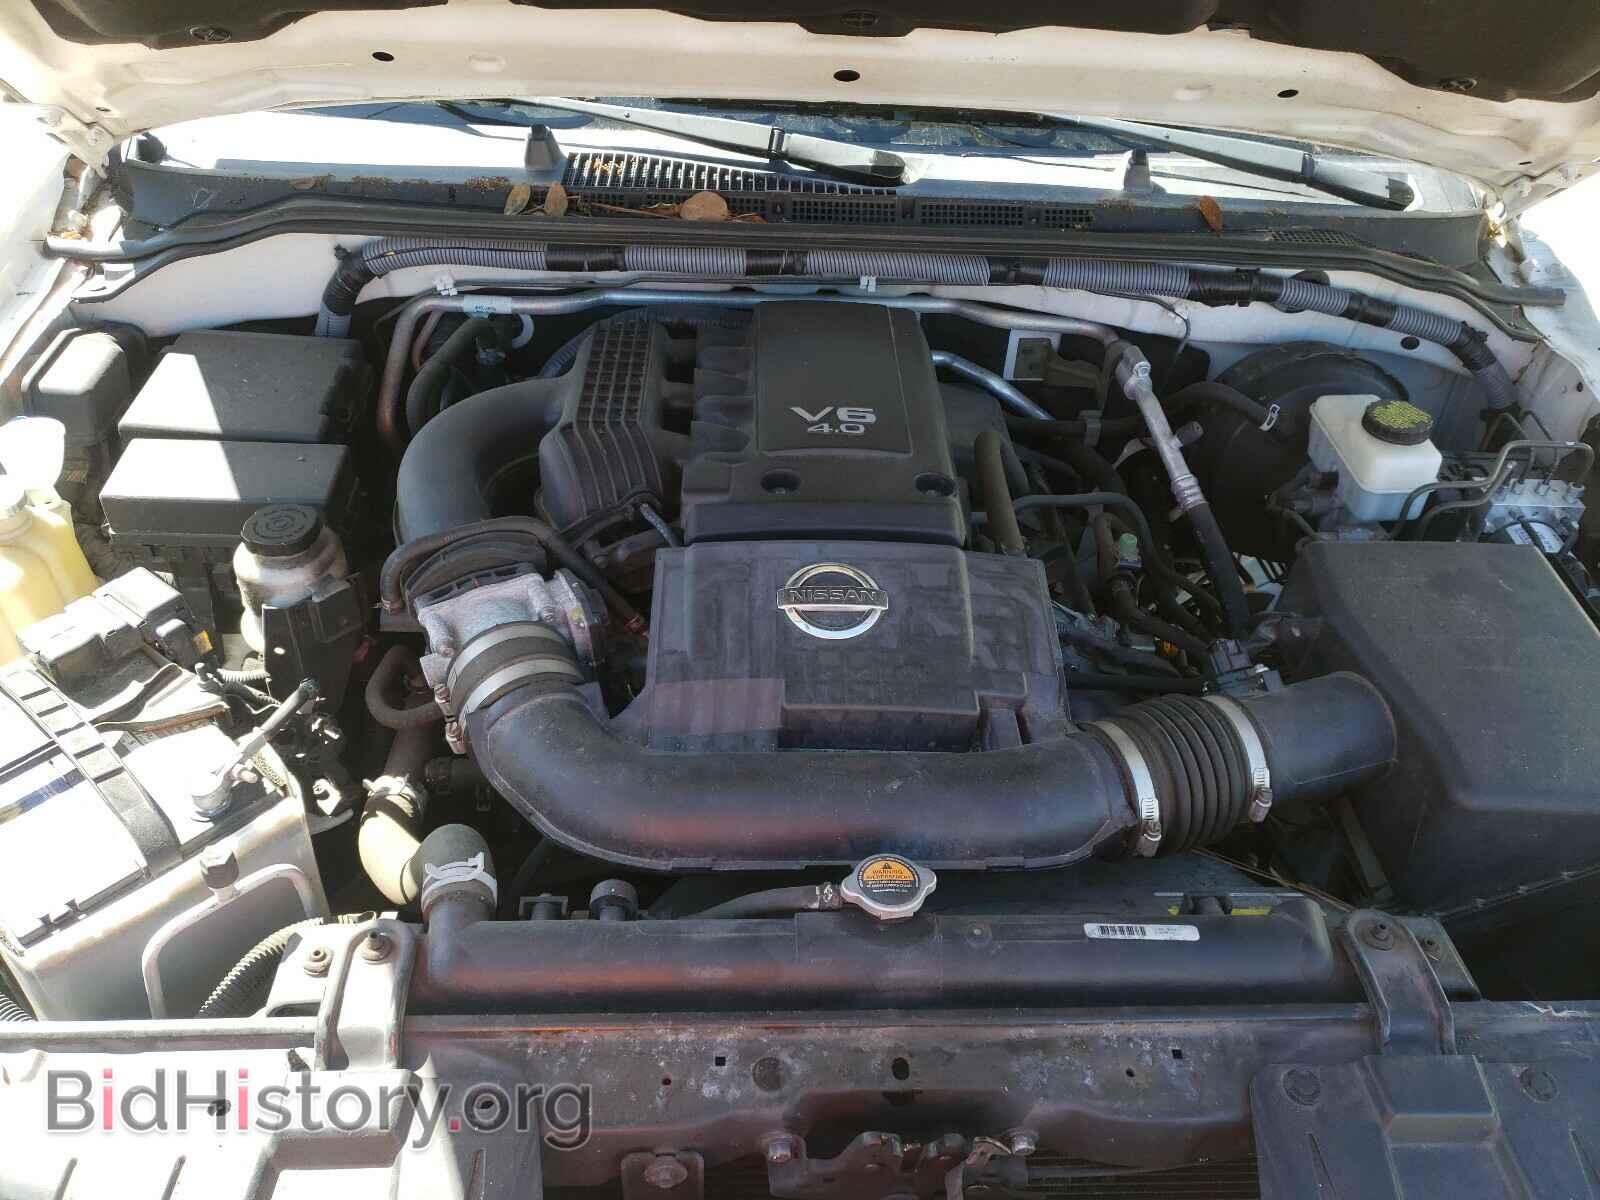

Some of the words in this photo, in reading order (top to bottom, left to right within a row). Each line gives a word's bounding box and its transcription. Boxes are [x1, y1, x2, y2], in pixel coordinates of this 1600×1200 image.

[789, 406, 877, 424] V6
[807, 423, 865, 434] 4.0
[788, 589, 877, 601] NISSAN
